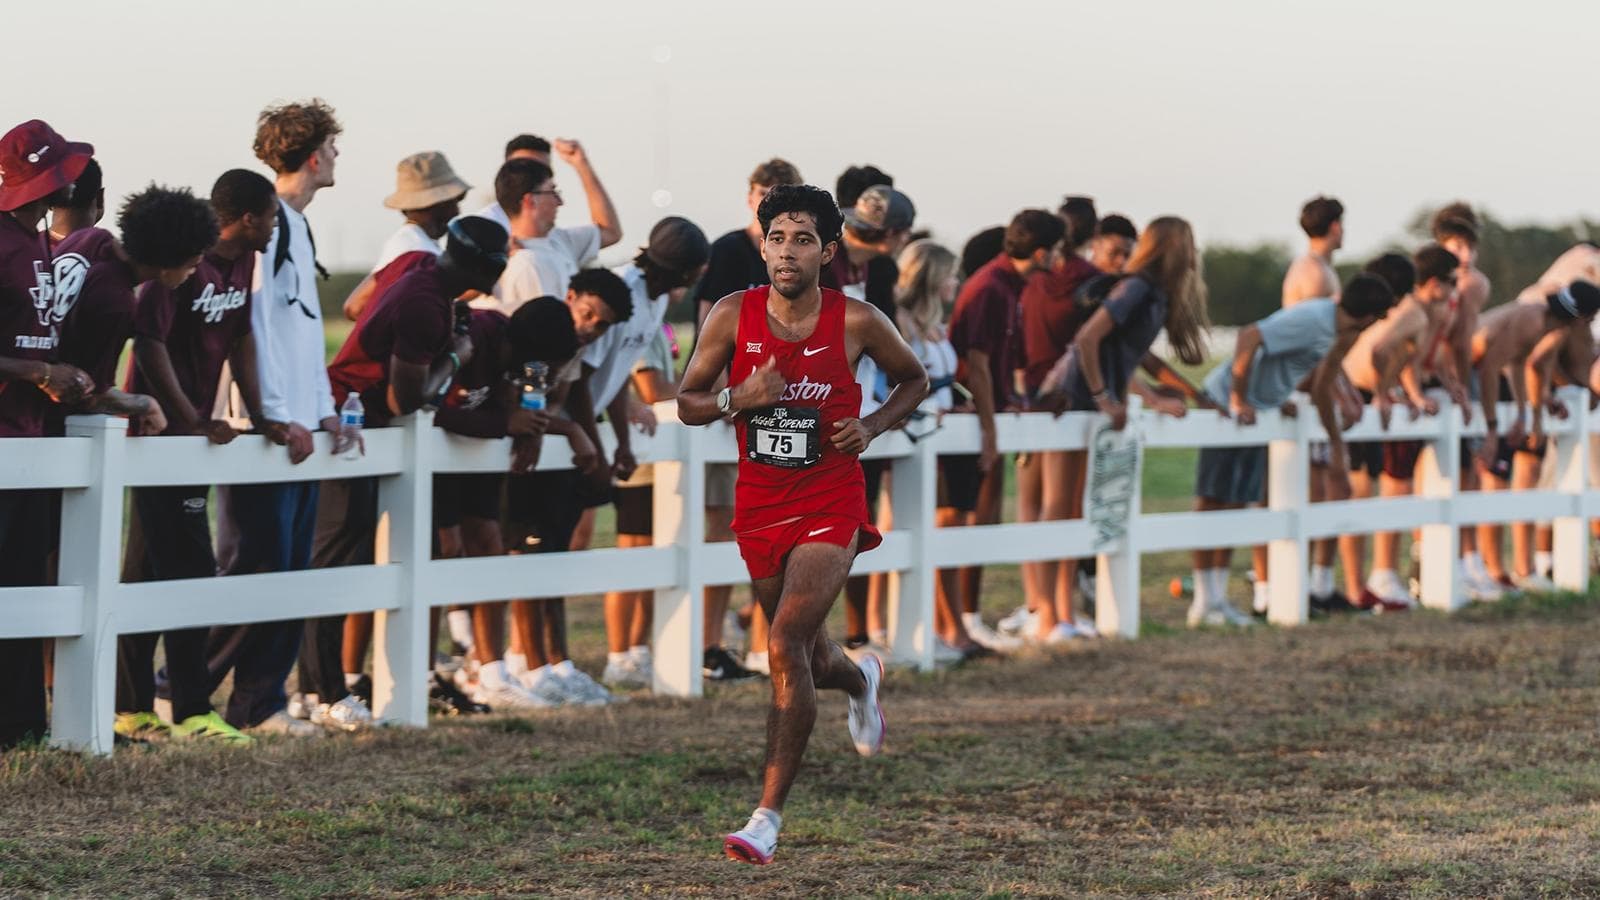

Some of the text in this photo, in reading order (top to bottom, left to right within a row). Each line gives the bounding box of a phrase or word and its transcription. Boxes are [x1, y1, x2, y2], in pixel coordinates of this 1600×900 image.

[192, 282, 248, 322] Aggies
[751, 415, 816, 429] AGGIE OPENER
[768, 434, 793, 455] 75
